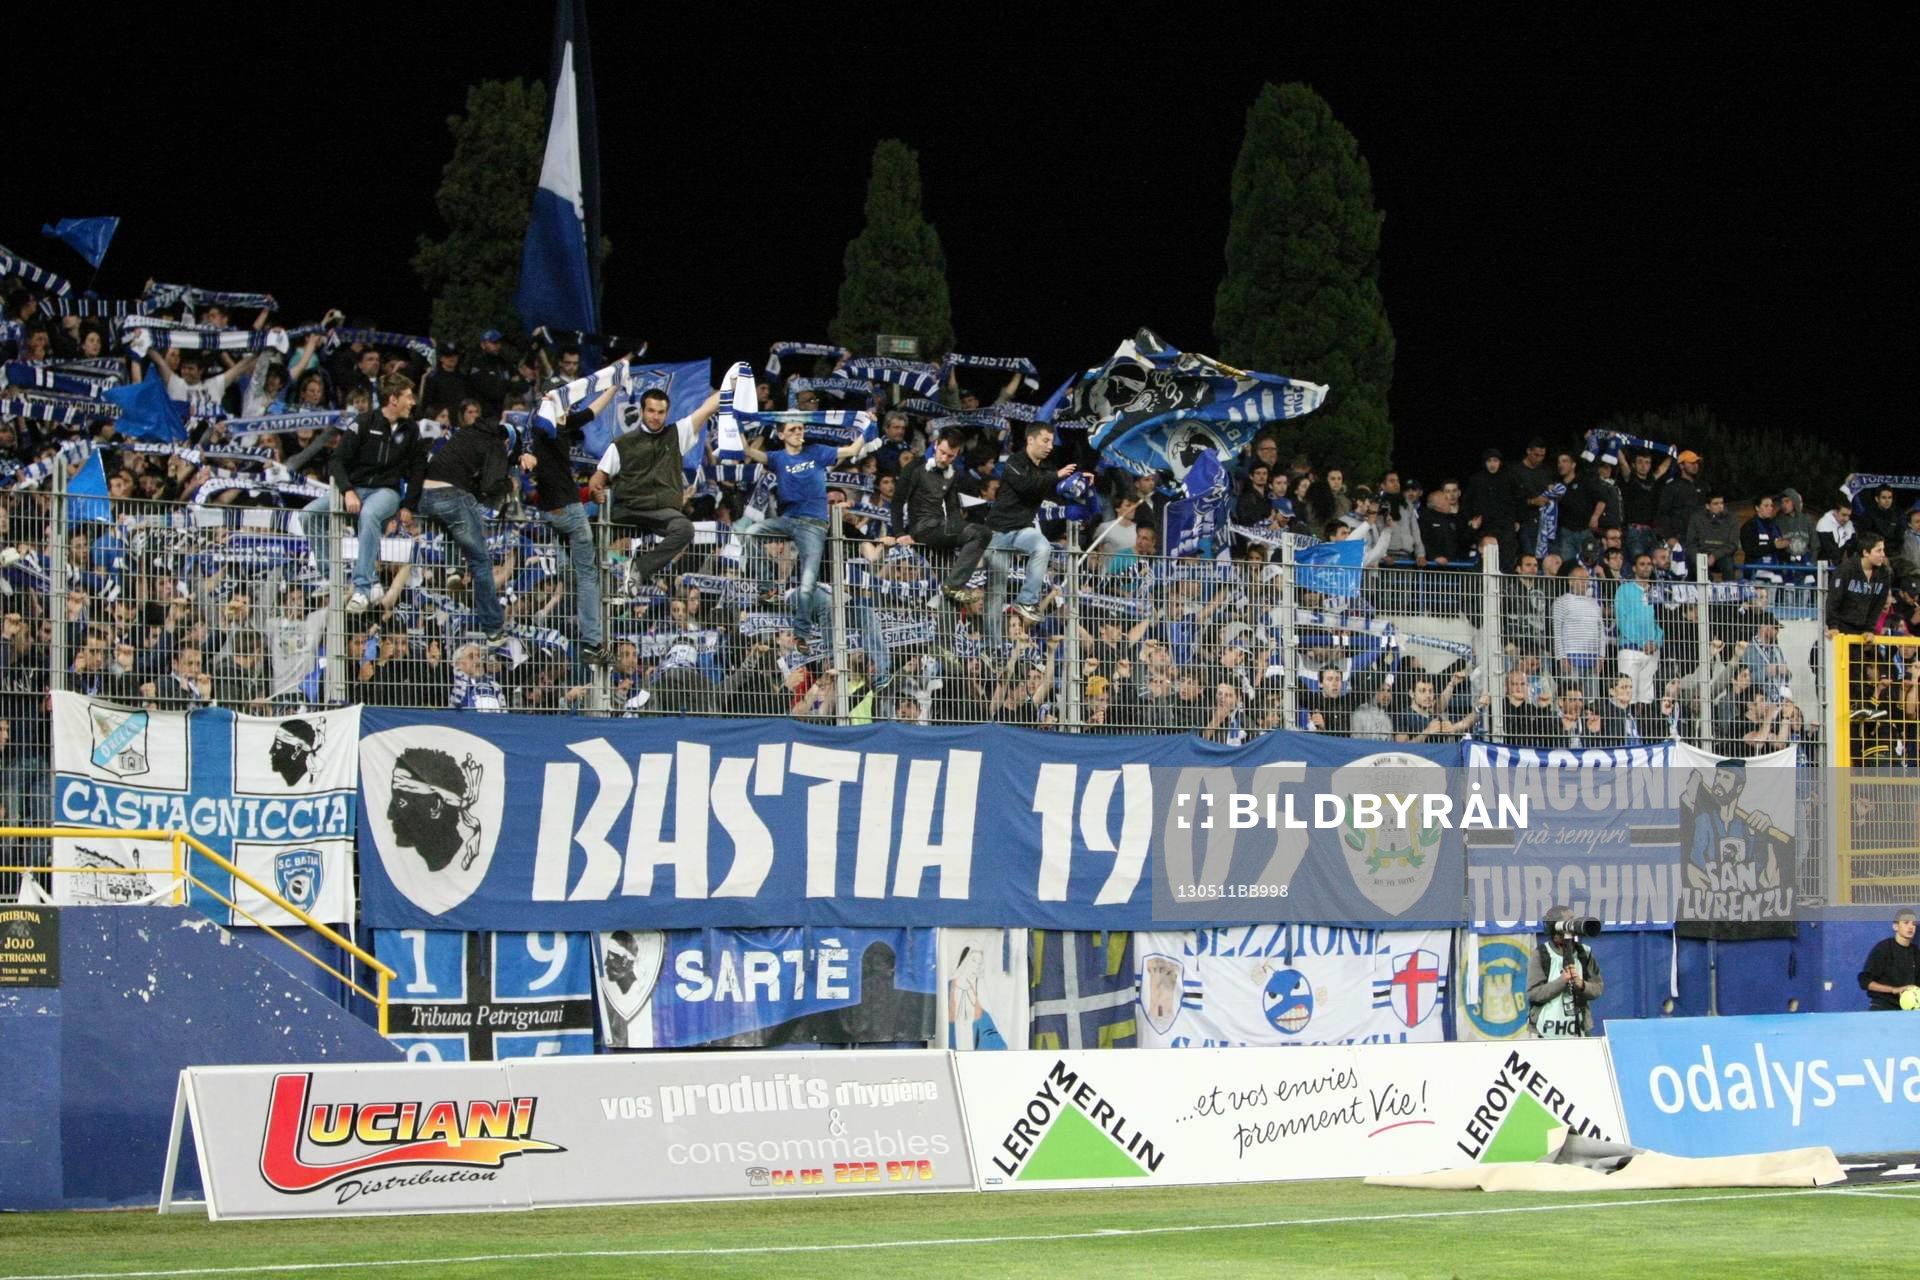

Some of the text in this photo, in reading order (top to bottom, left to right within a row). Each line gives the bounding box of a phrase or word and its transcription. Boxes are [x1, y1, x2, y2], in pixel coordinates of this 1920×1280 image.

[247, 415, 330, 432] CAMPIONI
[828, 471, 862, 484] STIA
[62, 781, 347, 838] CASTAGNICCIA
[532, 737, 1309, 905] BASTIA 1905
[1706, 861, 1756, 892] SAN
[1468, 863, 1682, 928] TURCHINI
[1682, 887, 1793, 922] LURENZU
[0, 953, 46, 962] ETRIGNANI
[4, 937, 34, 949] JOJO
[411, 1004, 565, 1030] Tribuna Petrignani
[1543, 1020, 1578, 1035] PHO
[600, 1096, 653, 1120] vos
[659, 1073, 830, 1123] produits
[1228, 1084, 1268, 1111] vos
[1274, 1067, 1359, 1102] envies
[828, 1109, 848, 1137] &
[992, 1080, 1060, 1177] LEROY
[1048, 1059, 1165, 1173] MERLIN
[1233, 1097, 1366, 1159] prennent
[1456, 1069, 1516, 1160] LEROY
[667, 1129, 951, 1165] consommables
[335, 1170, 497, 1205] Distribution
[771, 1169, 796, 1186] 04
[833, 1161, 881, 1184] 222
[886, 1159, 933, 1182] 978
